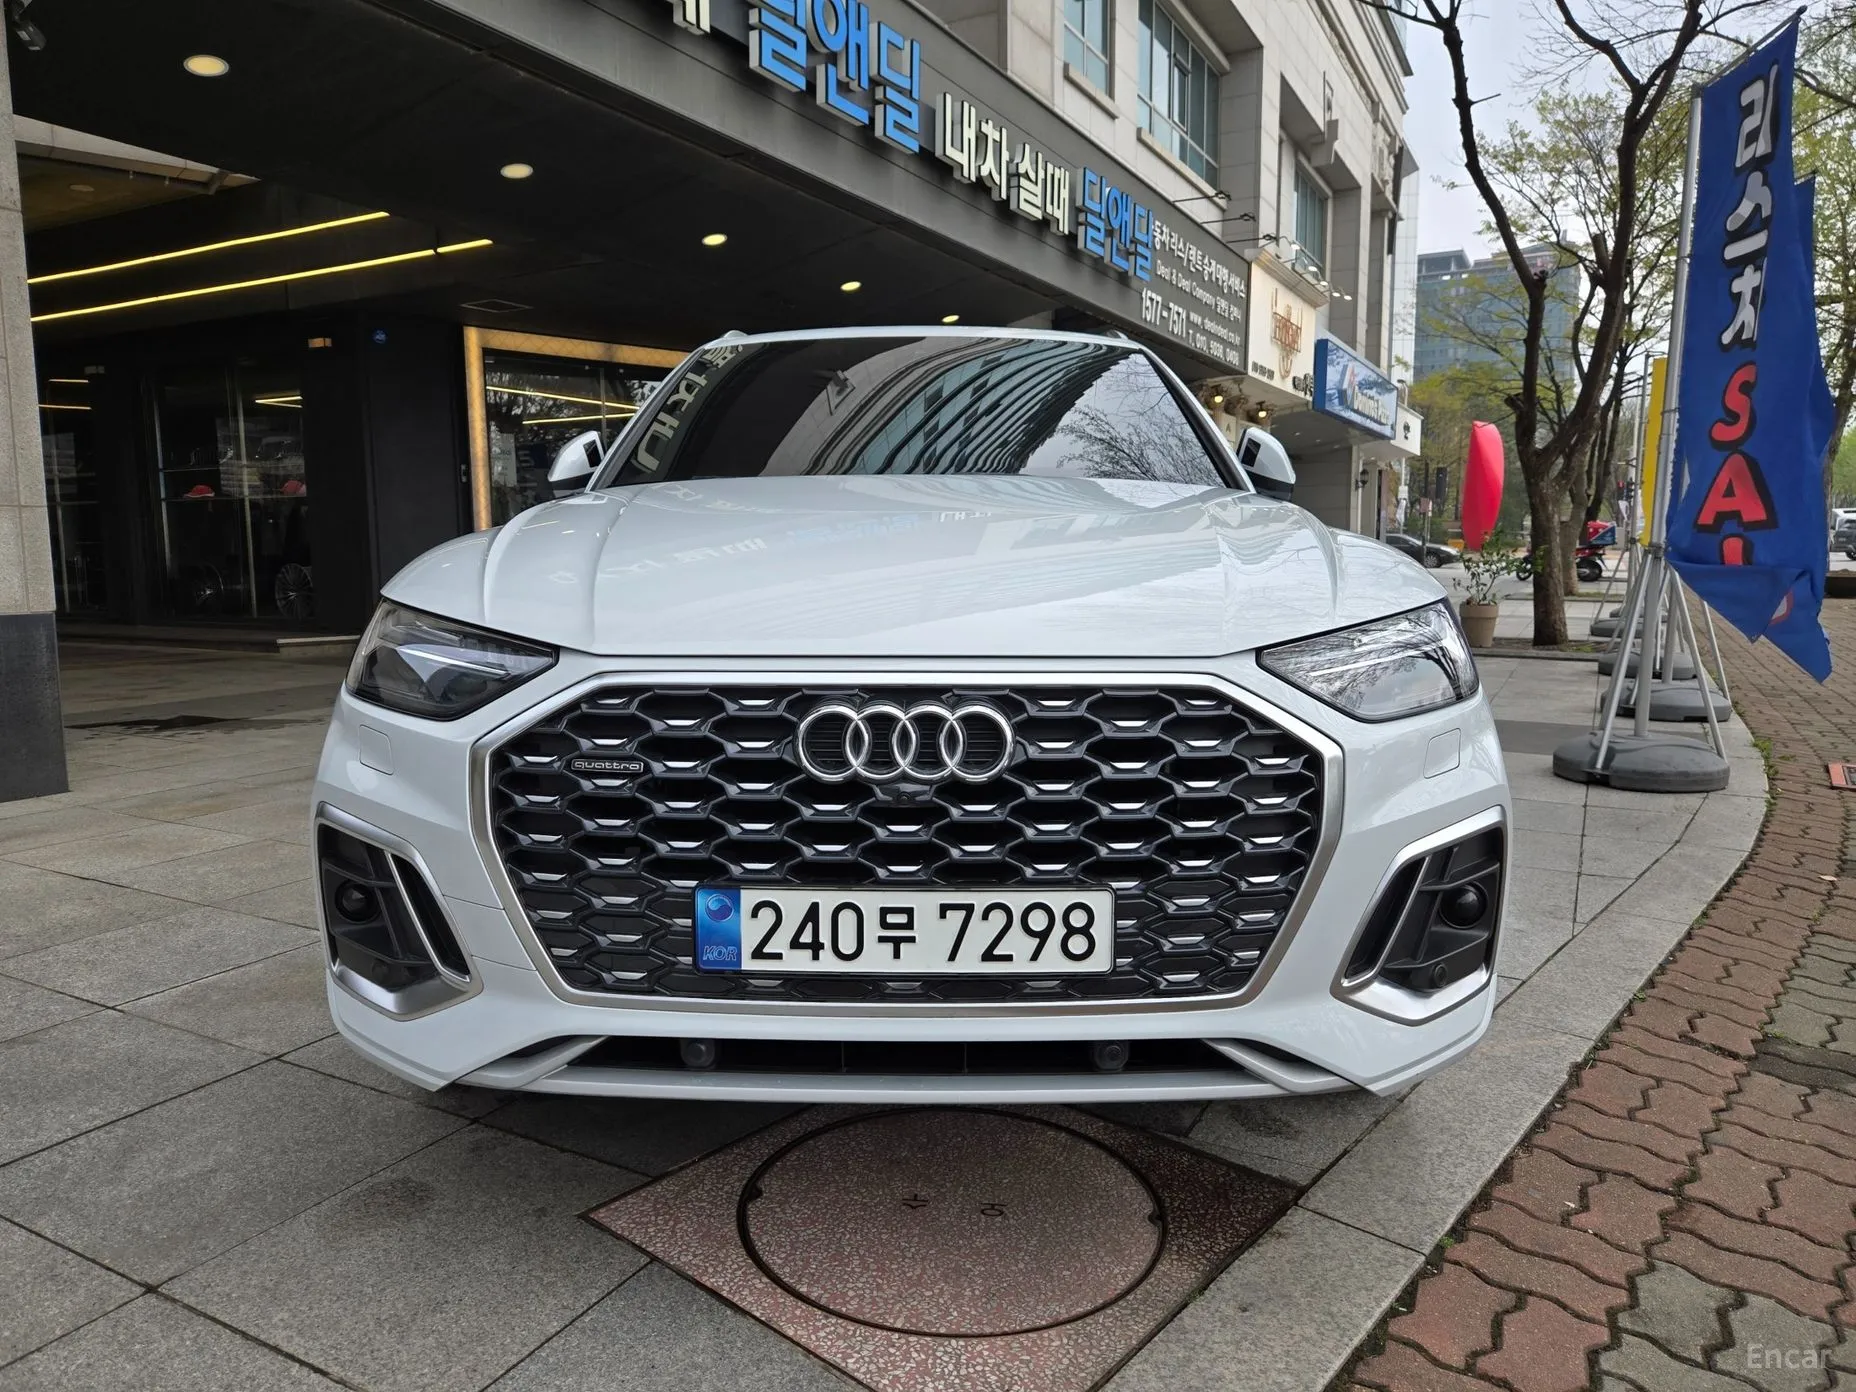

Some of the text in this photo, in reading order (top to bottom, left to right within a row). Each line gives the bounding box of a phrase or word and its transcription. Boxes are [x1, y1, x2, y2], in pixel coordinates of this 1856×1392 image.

[944, 92, 1008, 200] 내차
[1083, 166, 1154, 282] 딜앤딜
[1156, 259, 1171, 281] Deal
[1177, 273, 1191, 293] Deal
[1142, 287, 1187, 338] 1577-7571
[574, 761, 640, 770] quattro
[750, 900, 1096, 962] 240무 7298
[702, 945, 737, 961] KOR
